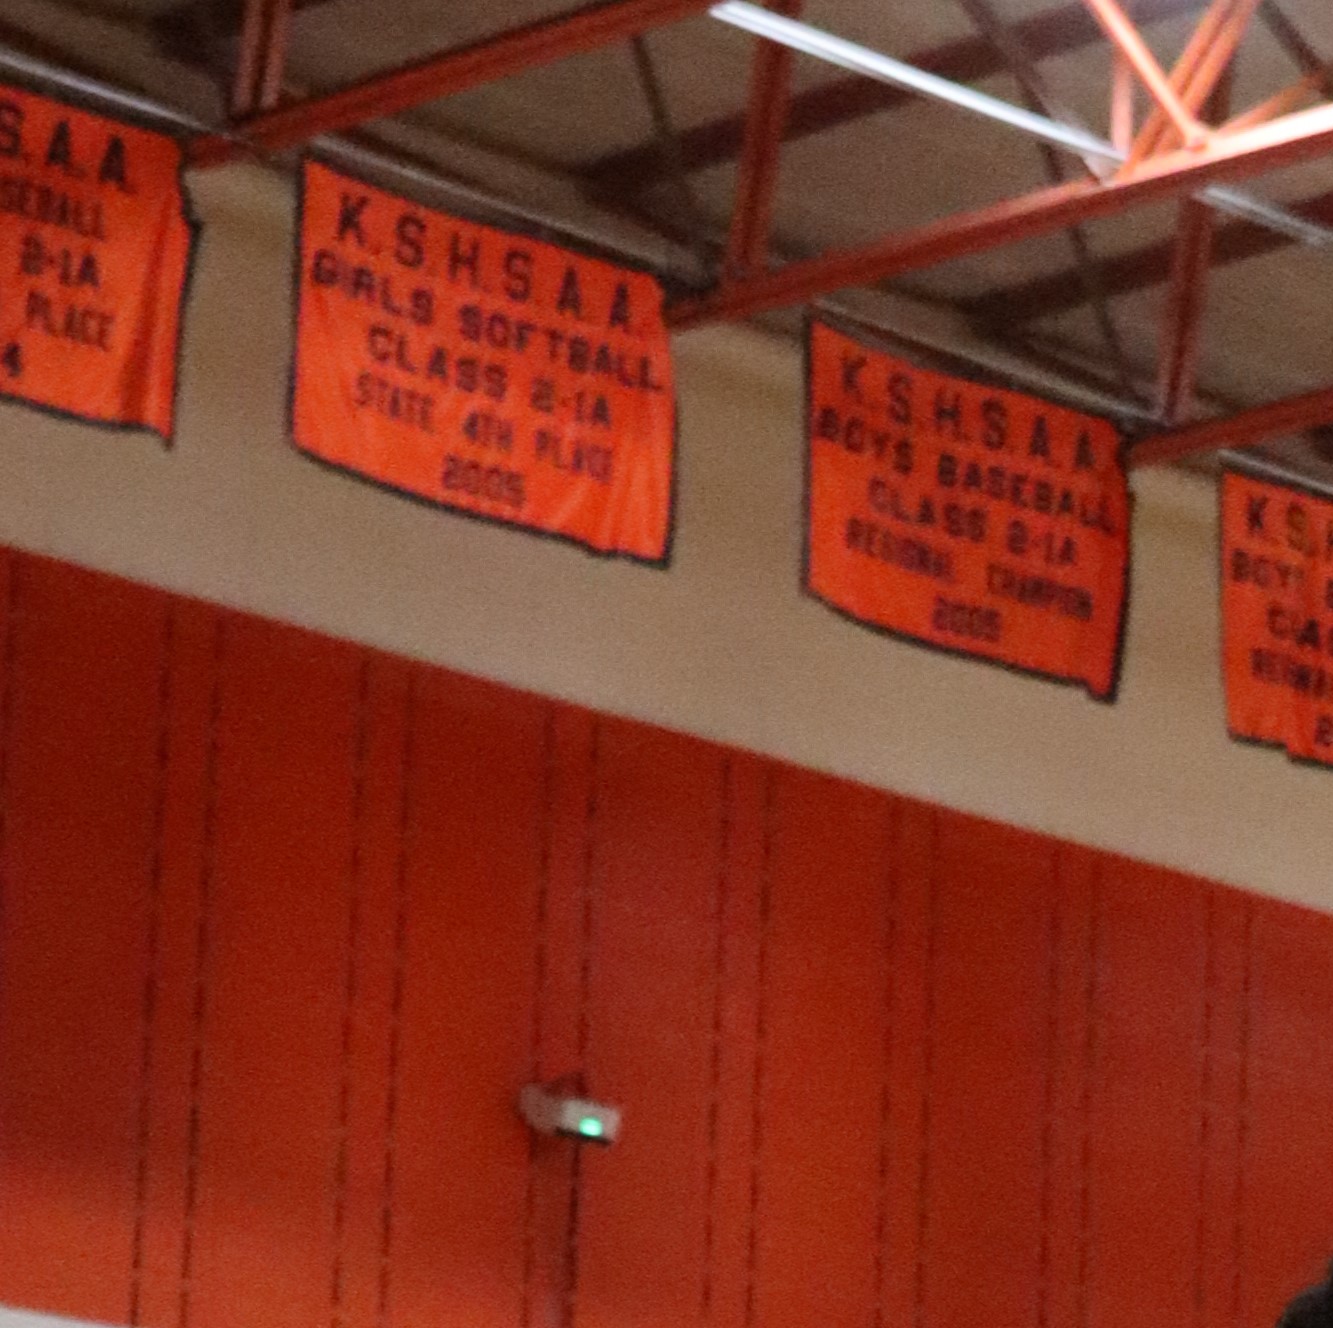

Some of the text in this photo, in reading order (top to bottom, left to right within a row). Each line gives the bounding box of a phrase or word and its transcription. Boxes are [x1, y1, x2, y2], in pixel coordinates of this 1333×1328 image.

[310, 246, 665, 393] GIRLS SOFTBALL
[366, 324, 508, 402] CLASS
[816, 406, 1116, 537] BOYS BASEBALL
[867, 475, 989, 544] CLASS
